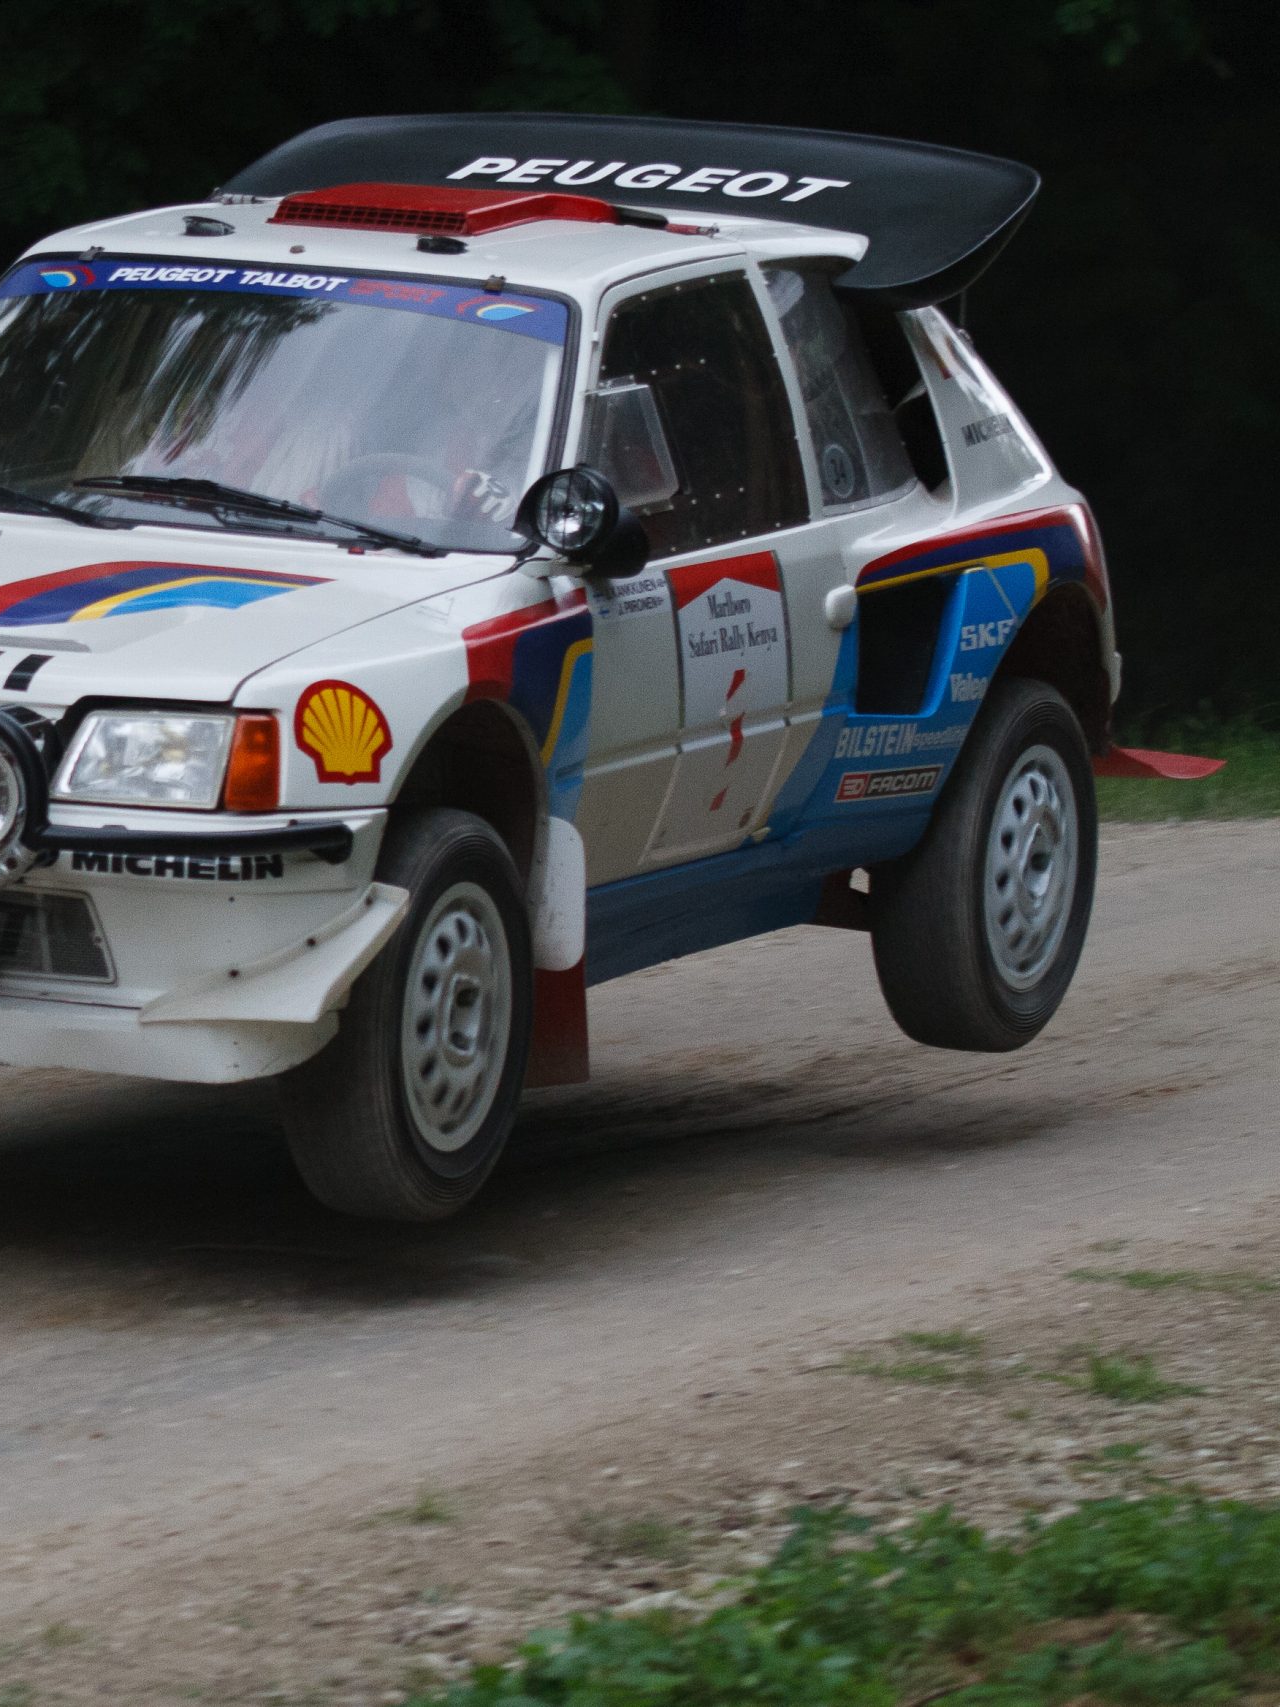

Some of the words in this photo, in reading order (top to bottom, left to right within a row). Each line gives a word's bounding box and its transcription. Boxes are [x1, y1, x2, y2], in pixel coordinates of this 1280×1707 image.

[446, 156, 851, 202] PEUGEOT
[108, 267, 234, 283] PEUGEOT
[239, 270, 349, 292] TALBOT
[706, 591, 751, 620] Marlboro
[688, 631, 720, 658] Safari
[719, 625, 746, 657] Rally
[747, 621, 779, 651] Kenya
[960, 619, 1016, 651] SKF
[834, 722, 918, 759] BILSTEIN
[867, 770, 937, 794] FACOM
[72, 851, 284, 881] MICHELIN
